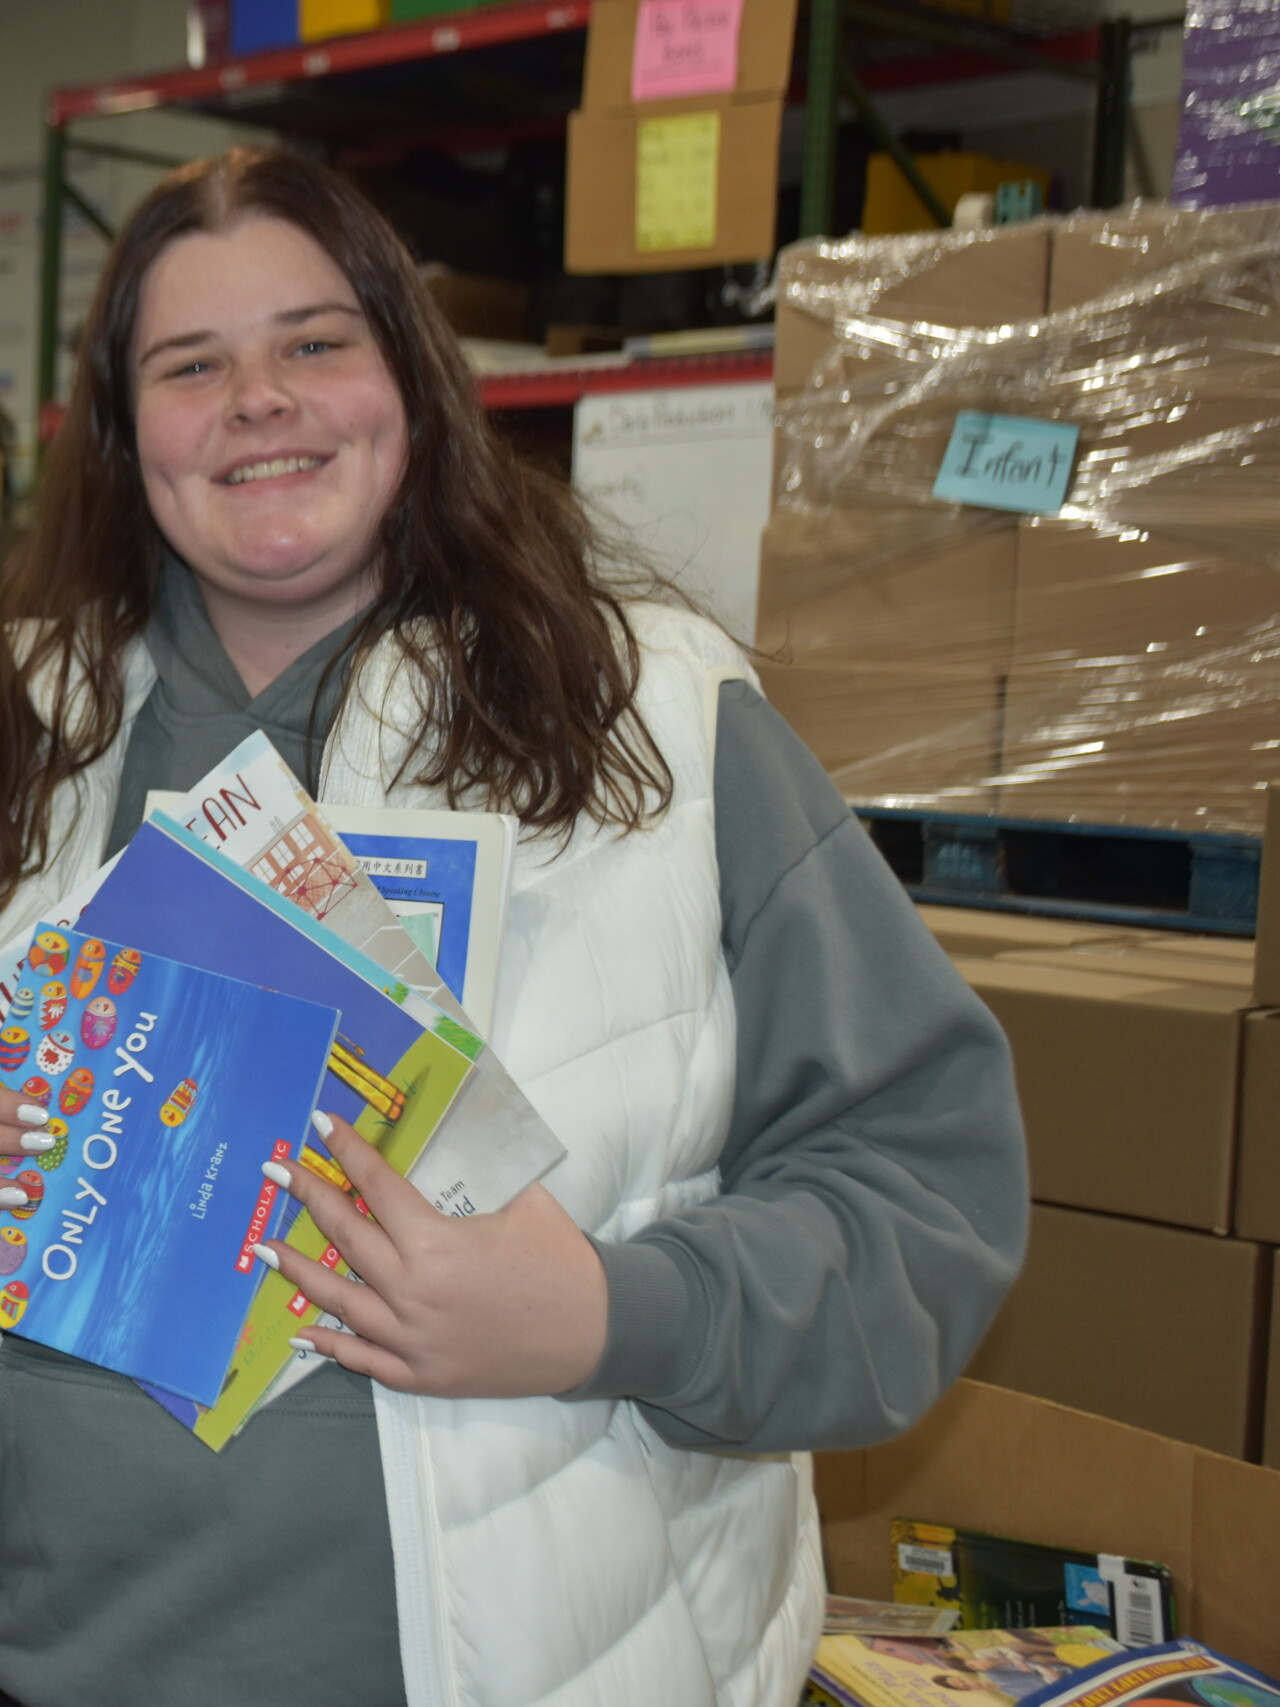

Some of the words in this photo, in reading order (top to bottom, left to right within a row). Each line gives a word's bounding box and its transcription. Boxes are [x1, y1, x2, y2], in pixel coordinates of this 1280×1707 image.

[955, 435, 1066, 489] Infant
[186, 773, 261, 850] AN
[357, 860, 424, 876] 用中文系列書
[382, 886, 412, 897] Speaking
[414, 887, 441, 898] Chinese
[113, 1011, 158, 1083] You
[244, 1143, 286, 1254] SCHOLAIC
[440, 1180, 465, 1201] Team
